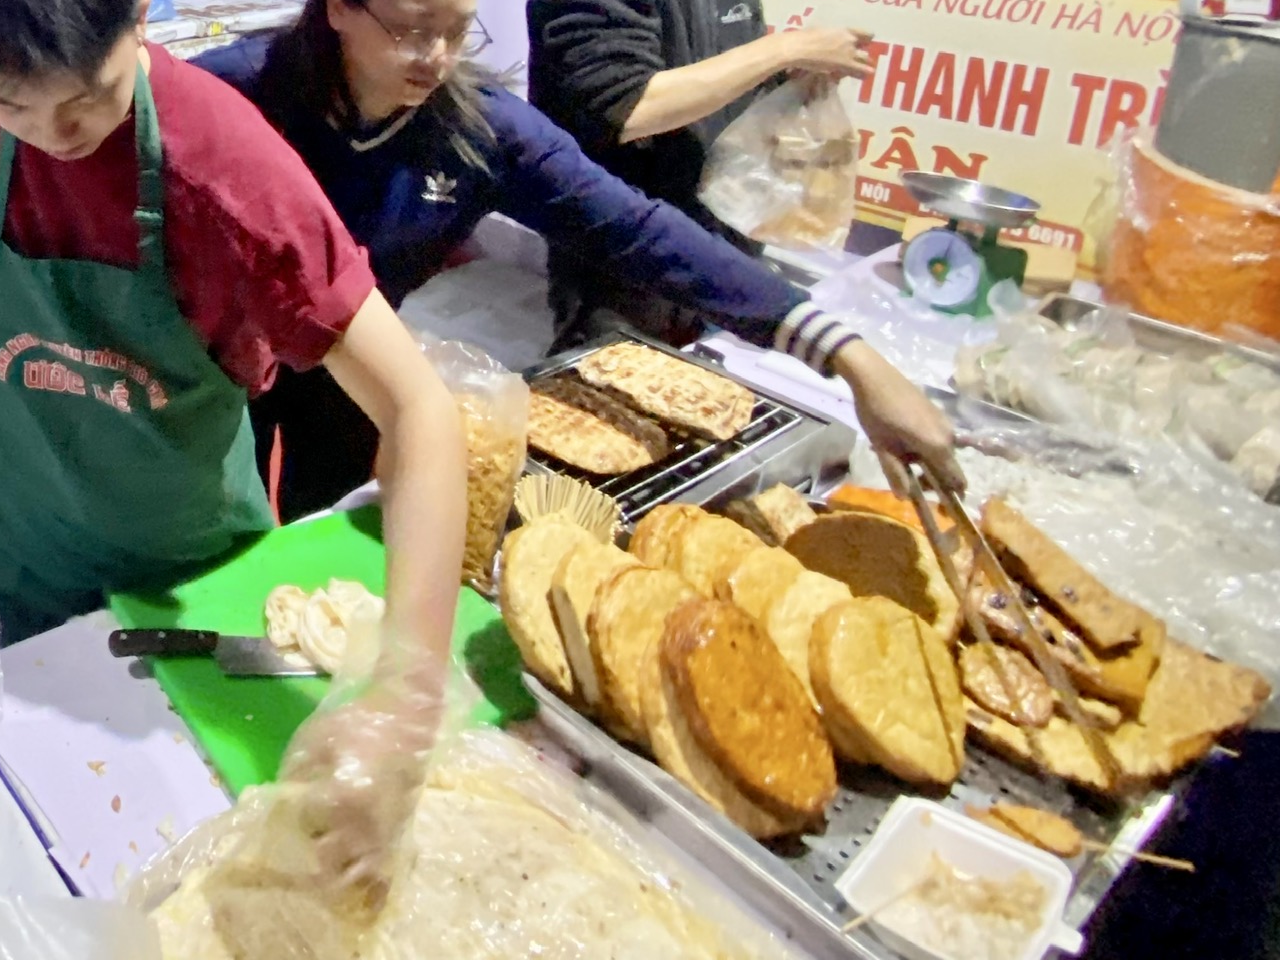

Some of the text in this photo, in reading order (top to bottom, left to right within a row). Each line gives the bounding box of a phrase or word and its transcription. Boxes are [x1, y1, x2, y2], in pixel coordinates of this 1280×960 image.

[1051, 0, 1103, 34] HÀ
[858, 40, 1050, 136] THANH
[860, 182, 891, 203] NỘI
